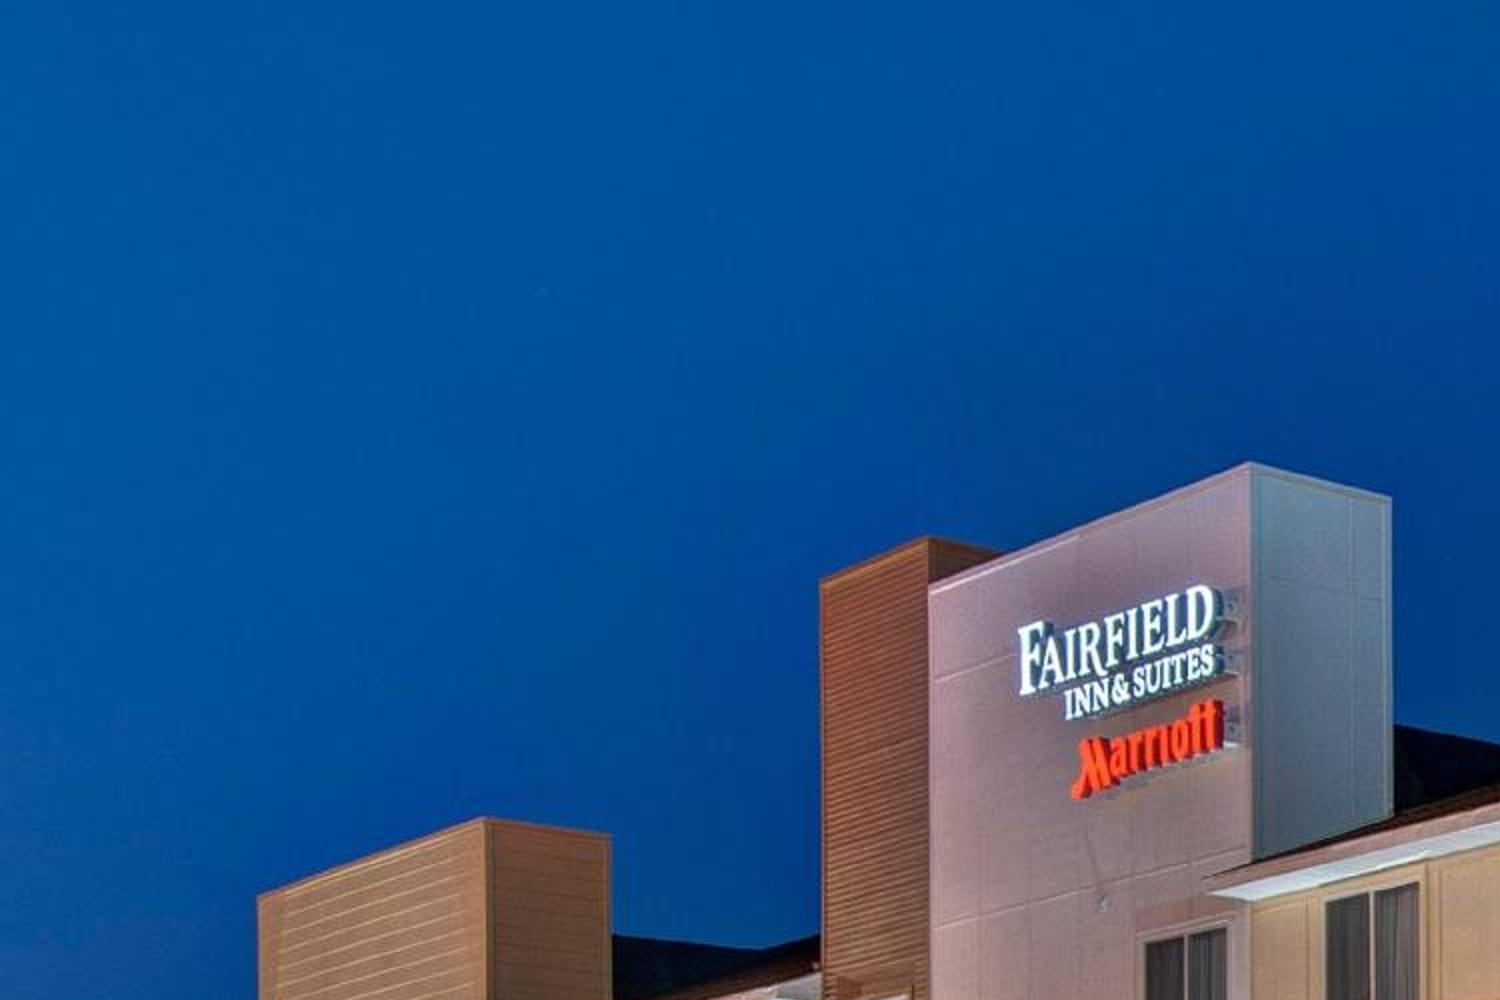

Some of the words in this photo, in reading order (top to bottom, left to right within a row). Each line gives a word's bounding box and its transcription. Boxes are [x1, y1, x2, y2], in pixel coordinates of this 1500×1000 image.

[1017, 584, 1220, 696] FAIRFIELD
[1132, 643, 1216, 698] SUITES
[1070, 698, 1222, 800] Marriott
